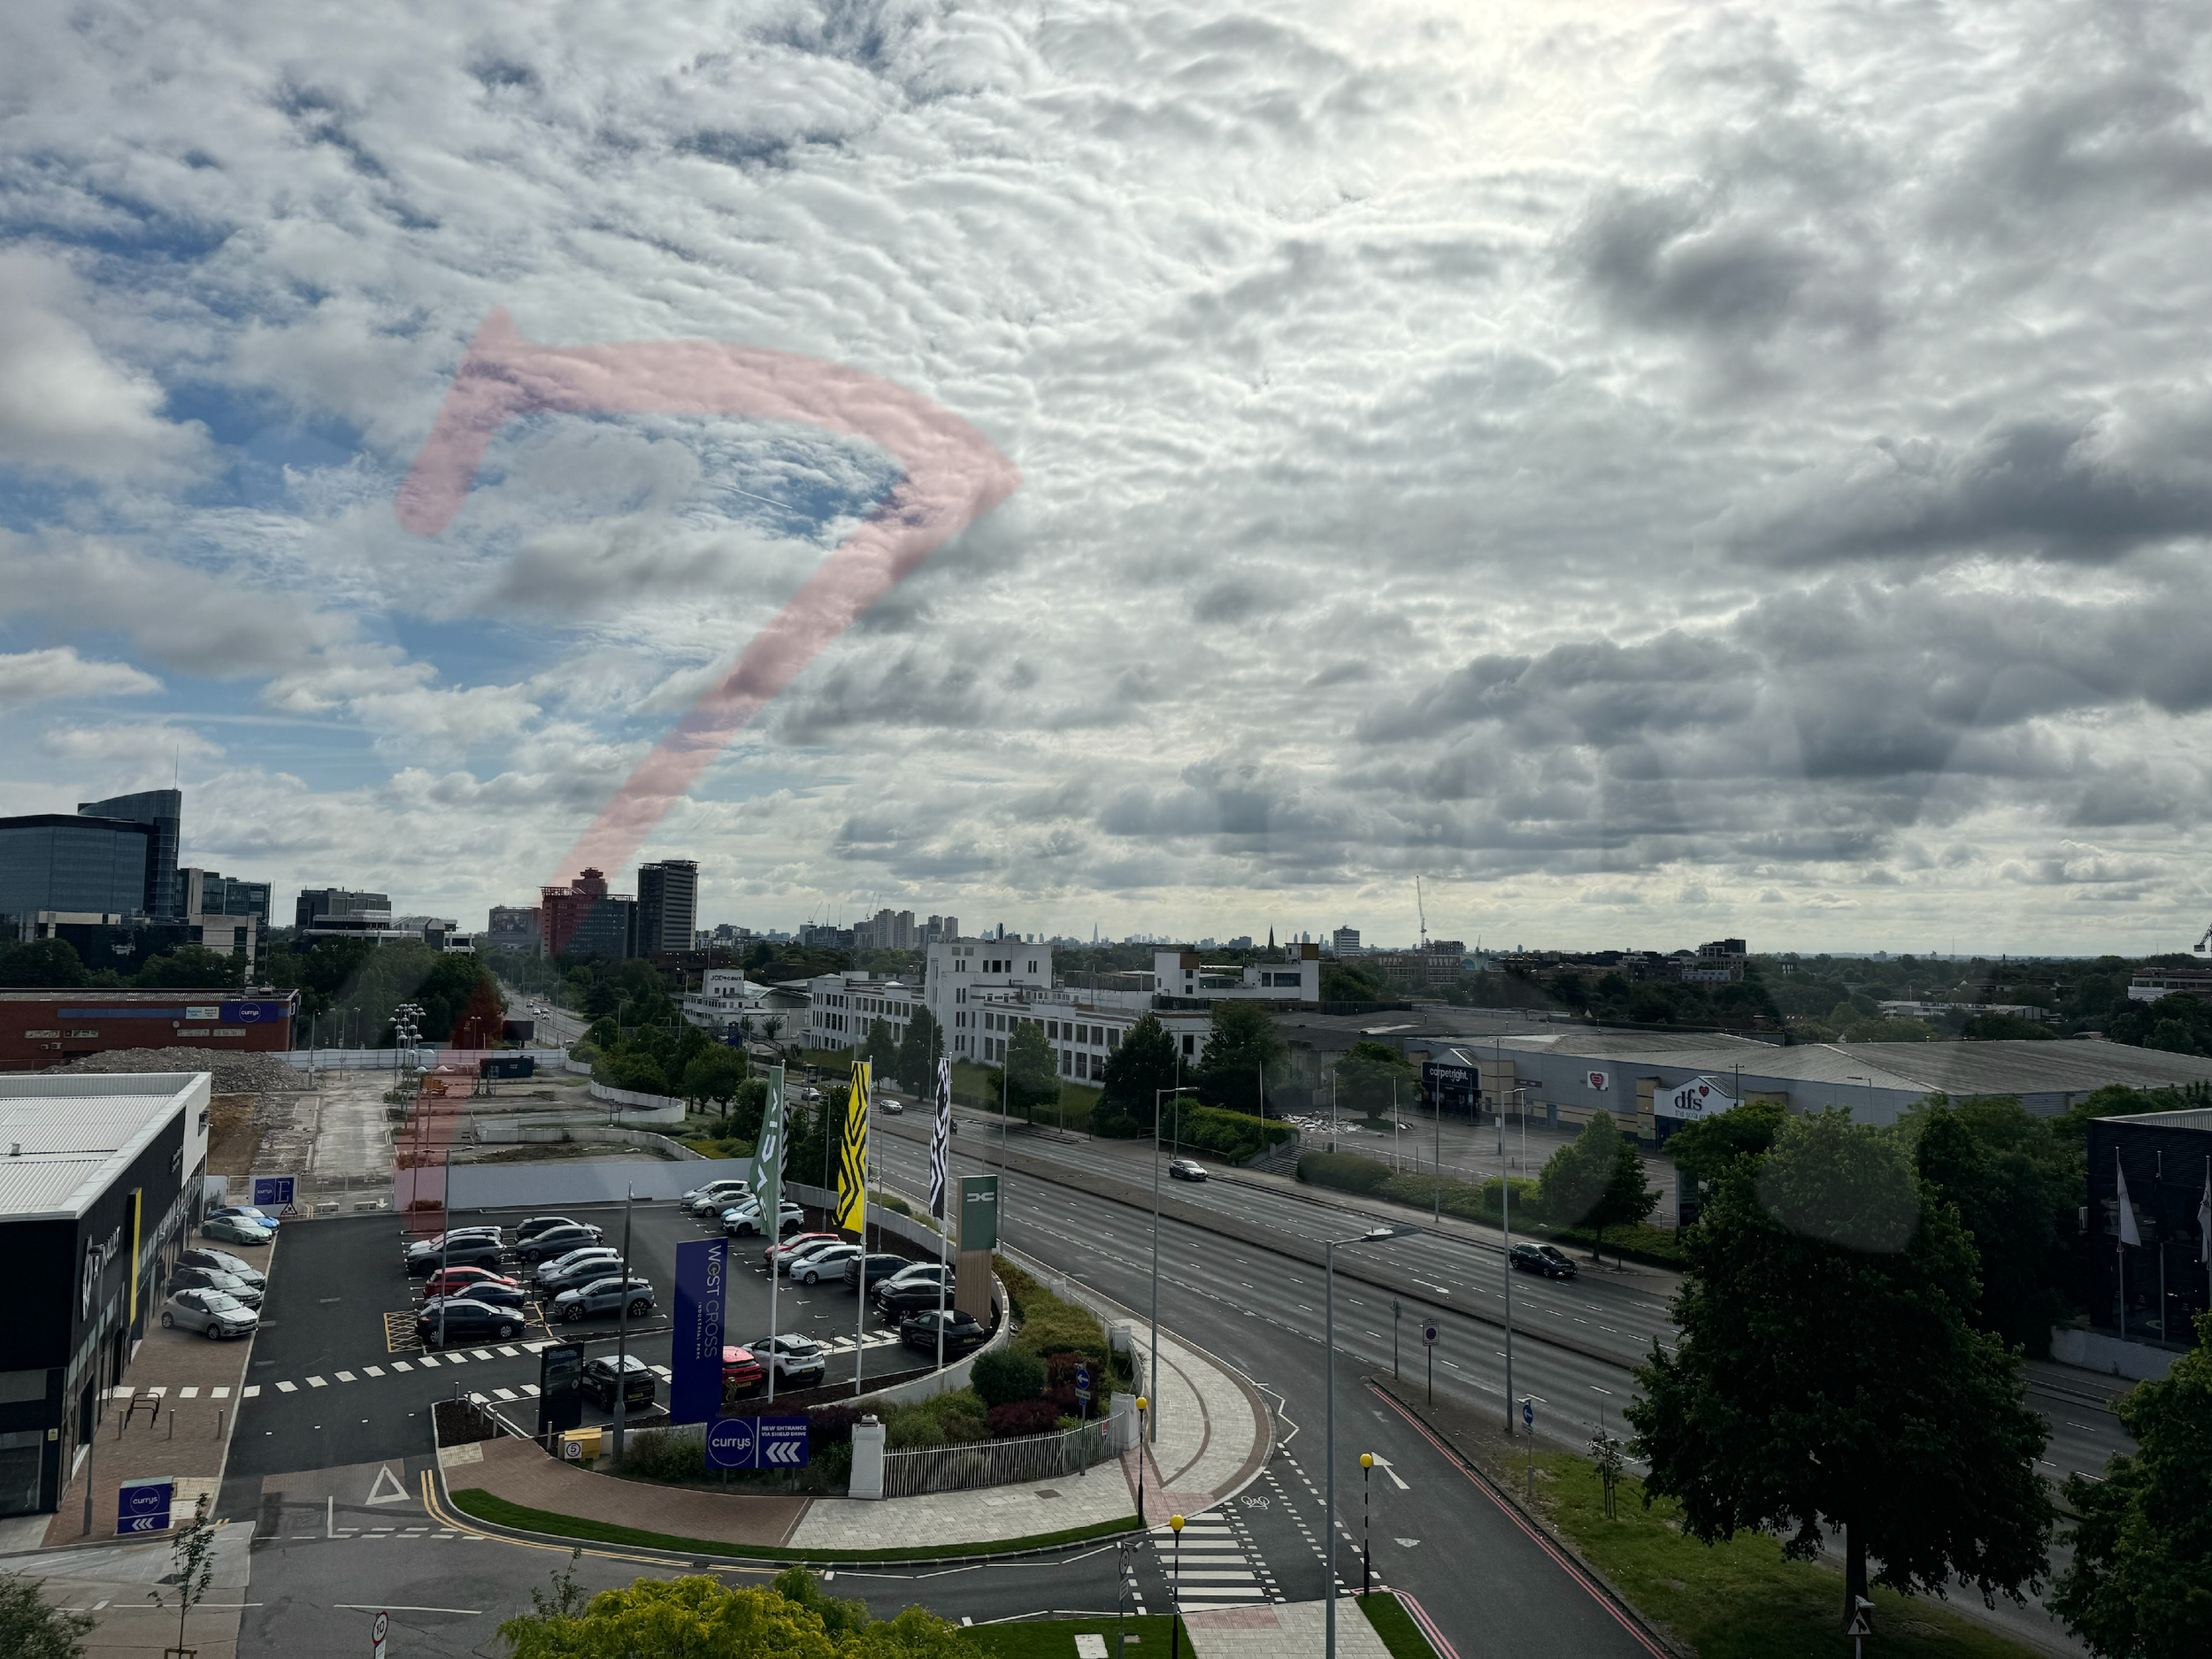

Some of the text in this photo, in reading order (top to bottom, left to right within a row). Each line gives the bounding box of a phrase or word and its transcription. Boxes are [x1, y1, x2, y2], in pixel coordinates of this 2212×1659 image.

[1674, 1088, 1702, 1111] dfs
[94, 1225, 120, 1280] RNAULT
[704, 1300, 719, 1358] CROSS
[712, 1438, 751, 1450] currys
[132, 1496, 158, 1505] currys
[376, 1621, 385, 1635] 10
